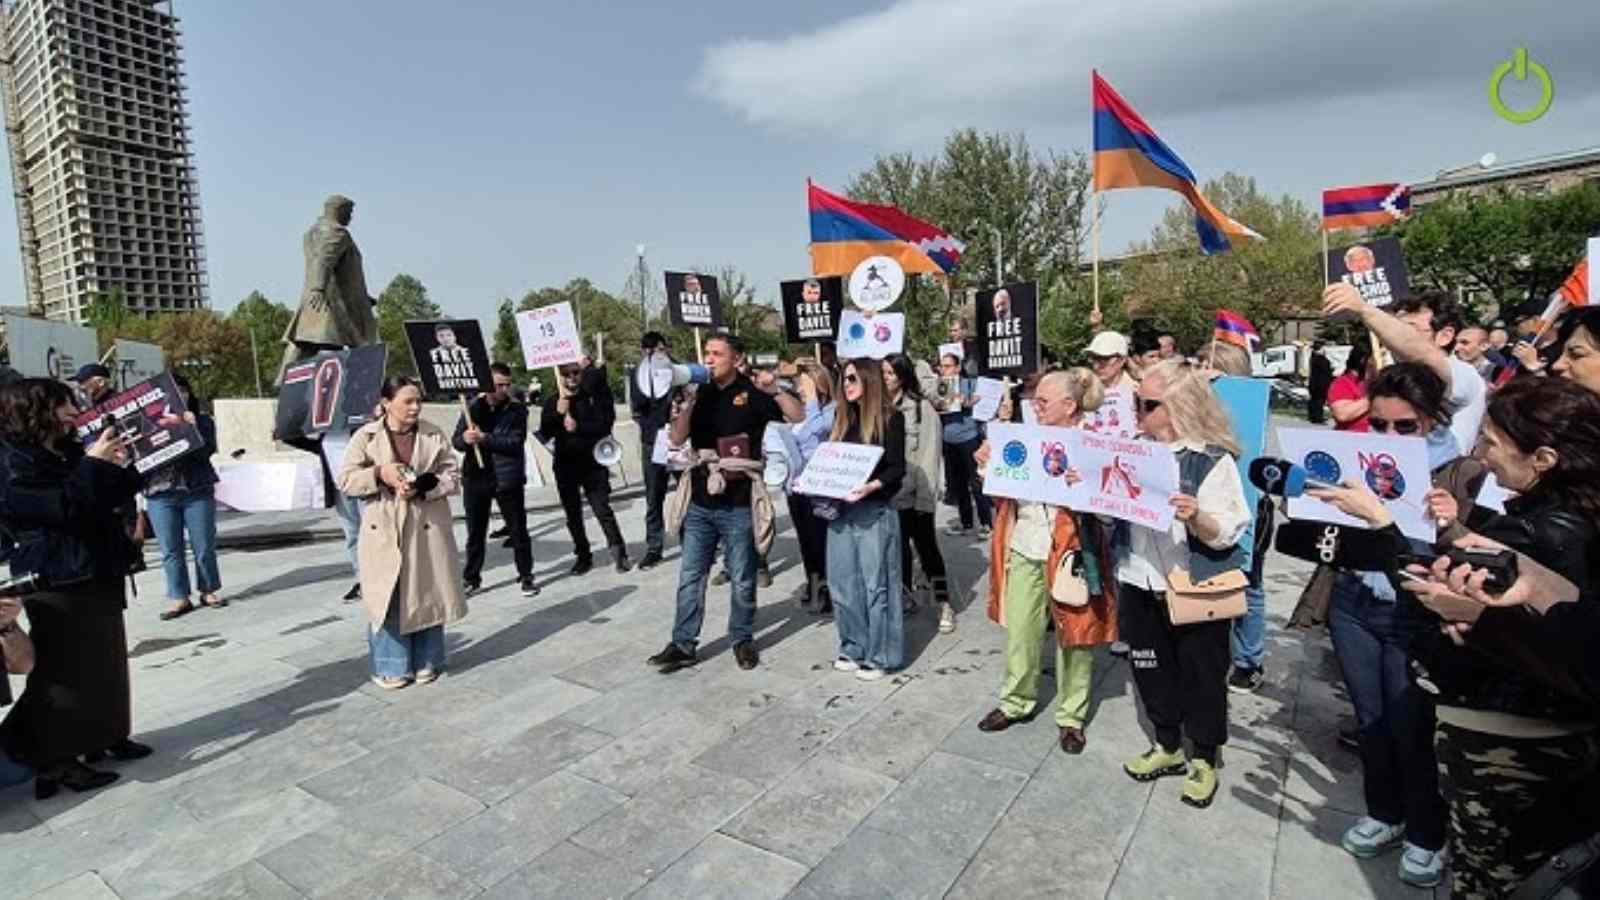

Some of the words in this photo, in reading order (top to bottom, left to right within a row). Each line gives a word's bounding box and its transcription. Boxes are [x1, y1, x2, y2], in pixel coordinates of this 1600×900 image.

[1341, 267, 1387, 286] FREE
[680, 291, 709, 304] FREE
[796, 301, 831, 315] FREE
[799, 315, 831, 330] DAVIT
[988, 317, 1021, 337] FREE
[988, 336, 1022, 356] DAVIT
[430, 347, 471, 362] FREE
[433, 361, 474, 378] DAVIT
[1041, 441, 1065, 457] NO
[1357, 451, 1397, 471] NO
